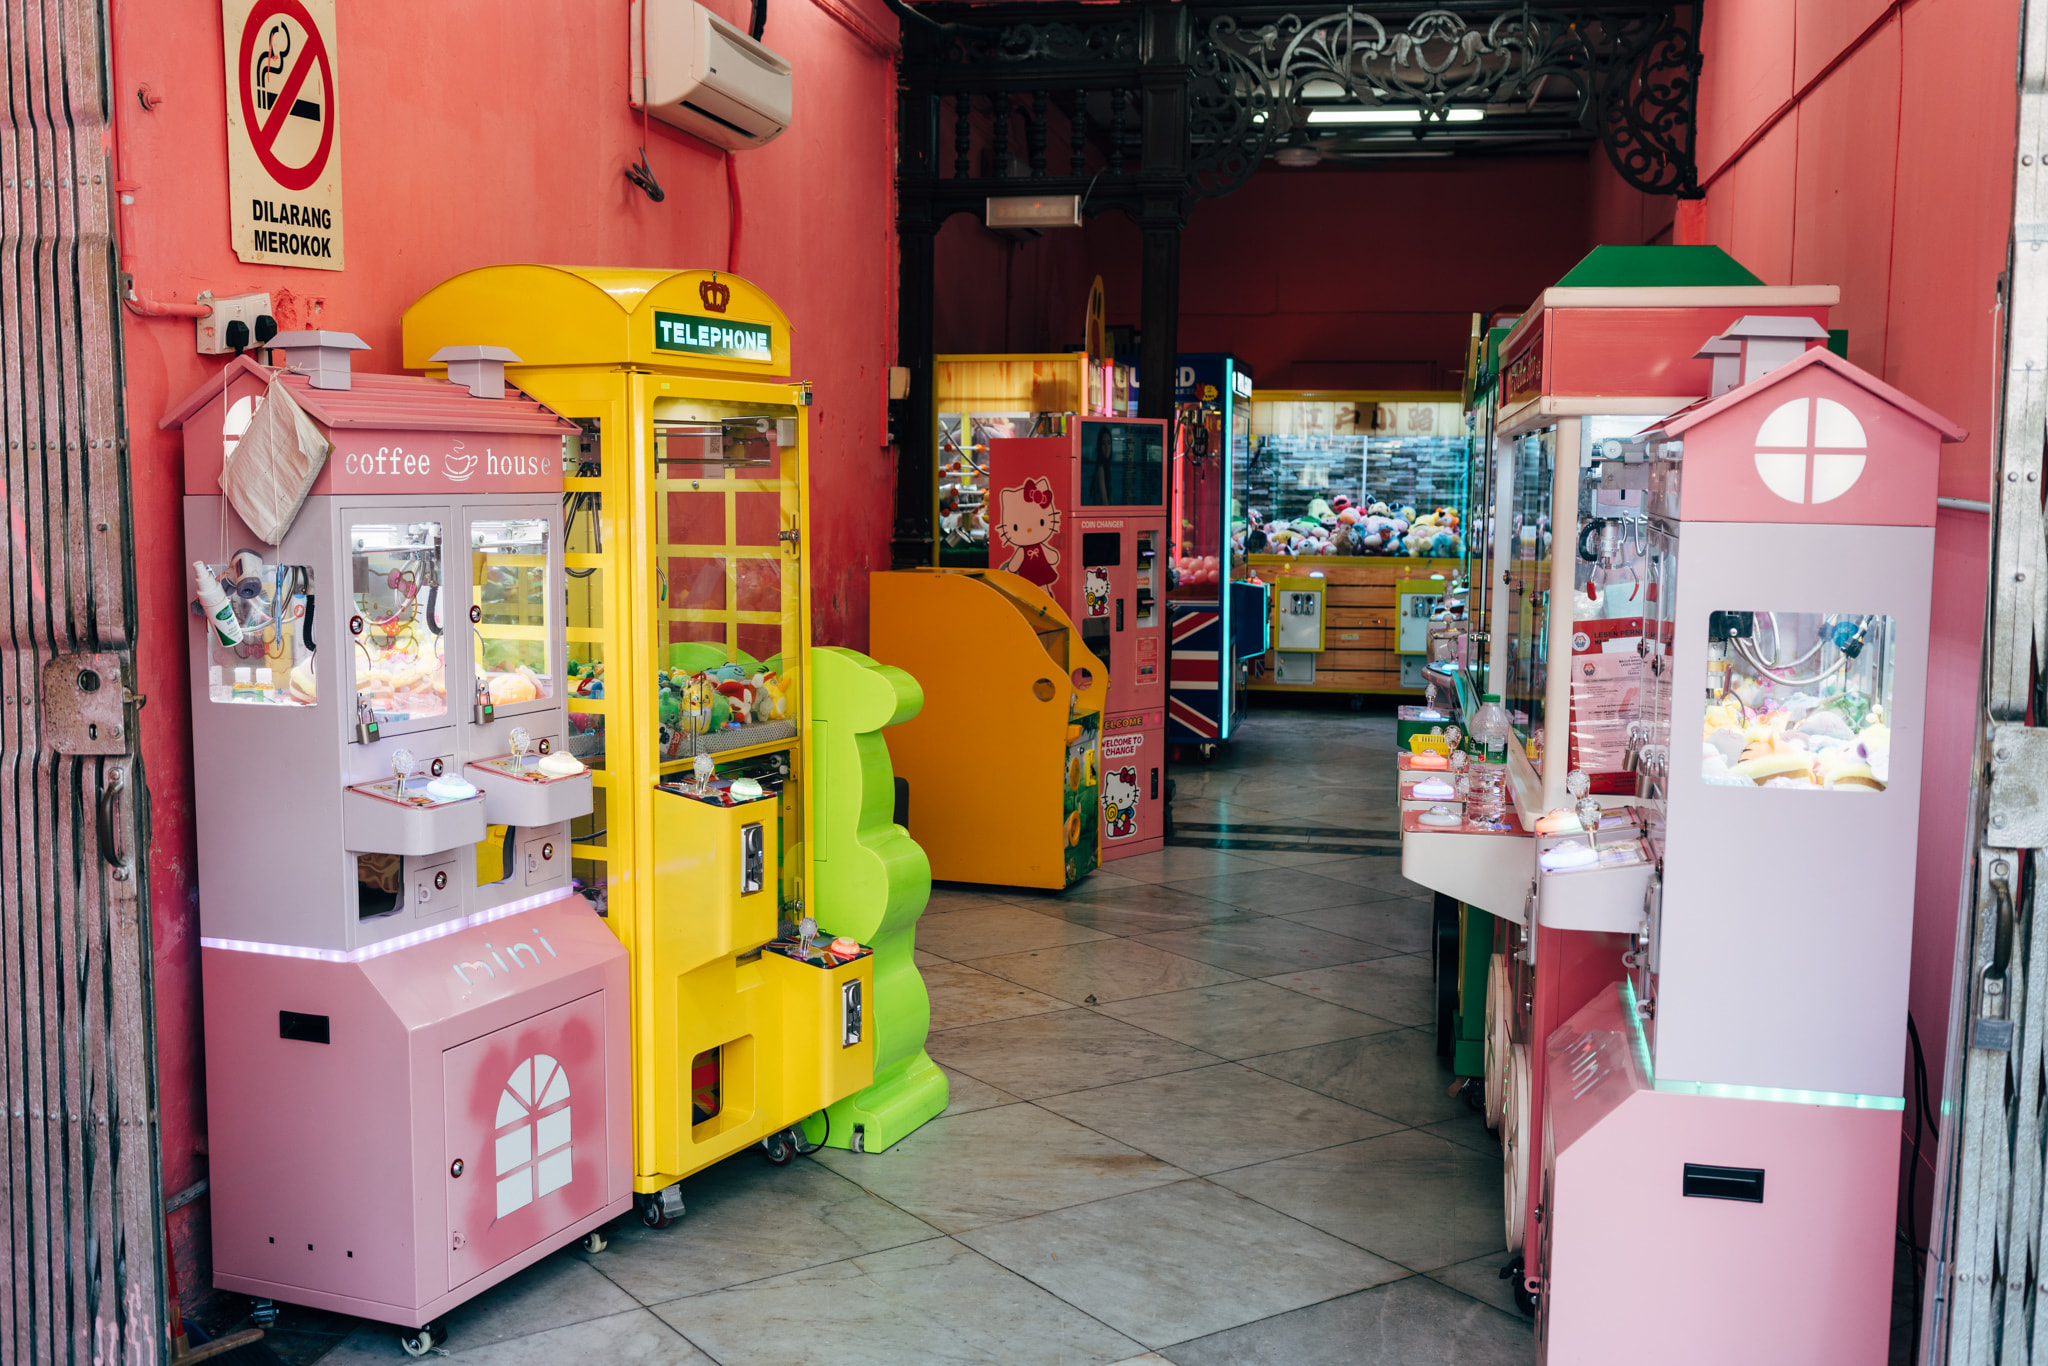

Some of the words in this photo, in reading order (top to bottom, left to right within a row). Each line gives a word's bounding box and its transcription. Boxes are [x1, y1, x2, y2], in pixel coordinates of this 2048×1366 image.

[252, 199, 332, 230] DILARANG
[254, 229, 332, 258] MEROKOK
[659, 320, 768, 353] TELEPHONE
[345, 447, 430, 475] coffee
[486, 448, 551, 475] house
[1081, 520, 1096, 529] COIN
[1096, 520, 1124, 529] CHANGER
[1593, 631, 1619, 639] LESEN
[1105, 746, 1134, 756] CHANGE
[1133, 736, 1142, 744] TO
[452, 927, 558, 986] mini
